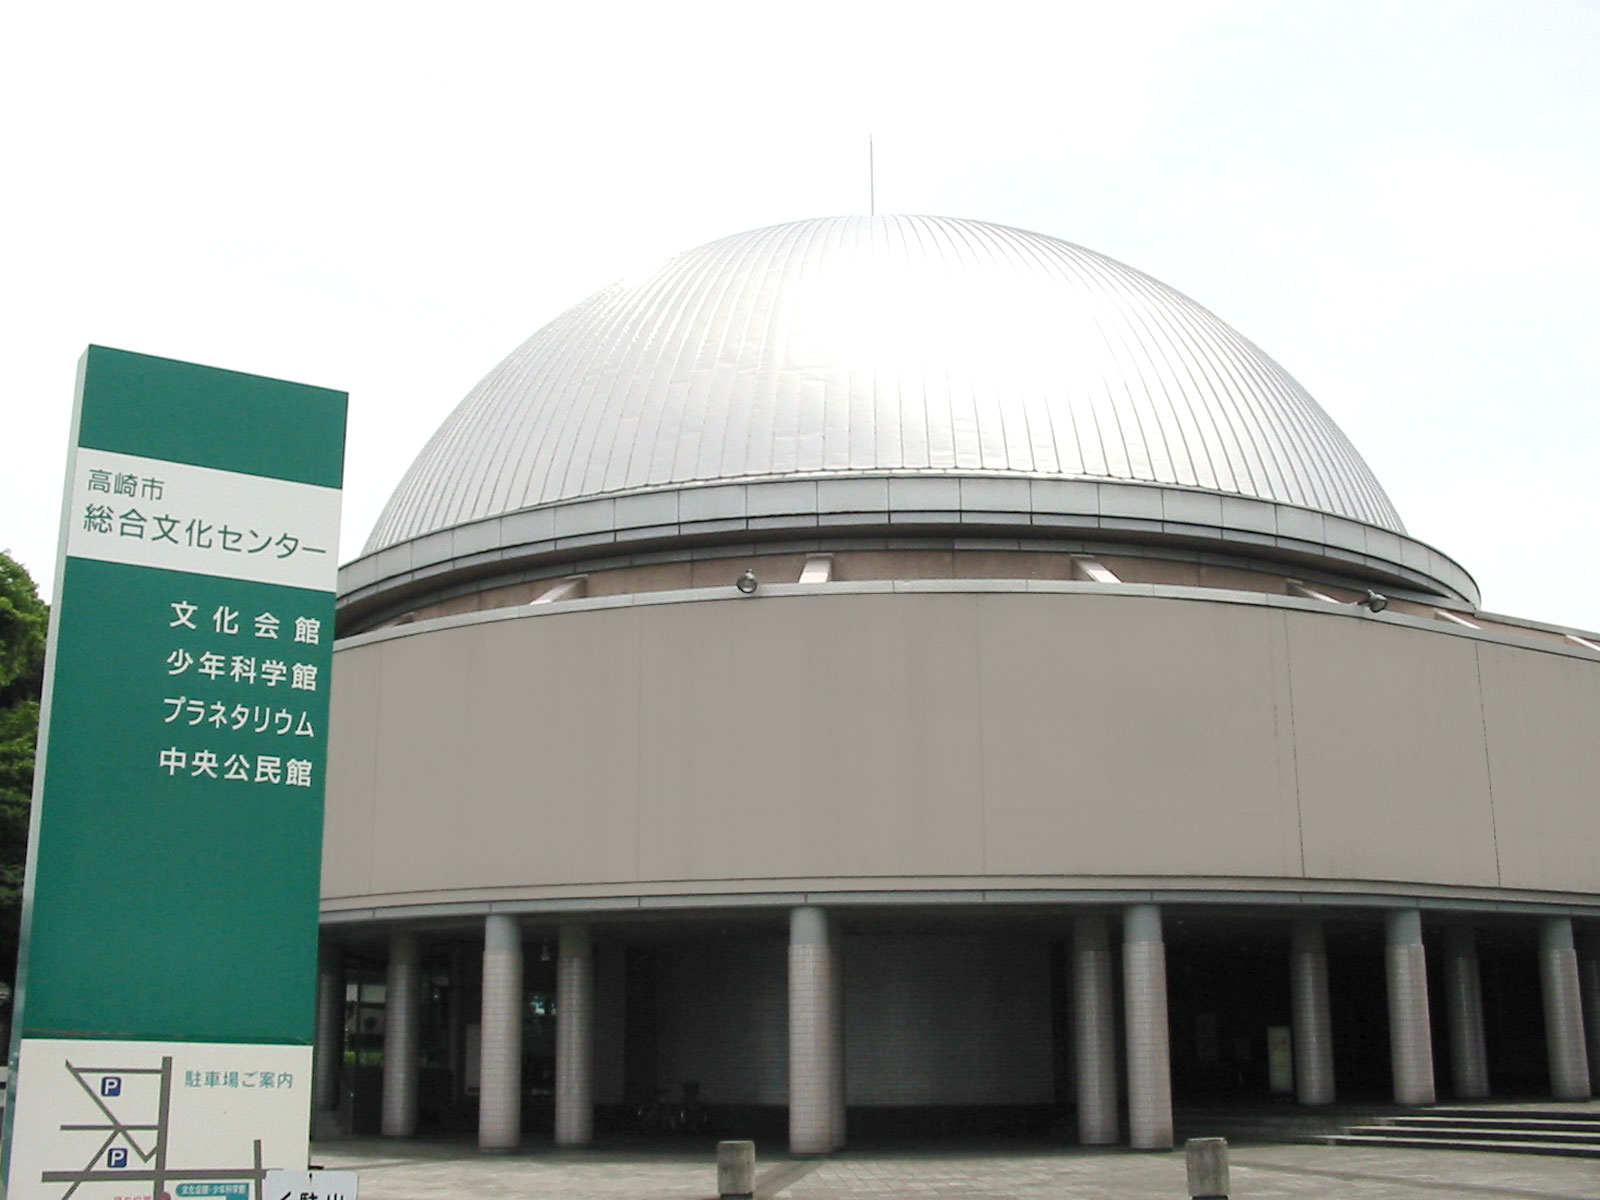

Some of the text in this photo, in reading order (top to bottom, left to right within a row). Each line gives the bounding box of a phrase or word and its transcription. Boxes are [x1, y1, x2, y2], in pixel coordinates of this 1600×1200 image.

[88, 469, 165, 500] 高崎市
[83, 503, 327, 559] 総合文化センター
[166, 648, 317, 691] 少年科学館
[163, 695, 315, 737] プラネタリウム
[159, 747, 313, 787] 中央公民館
[184, 1070, 293, 1088] 駐車場ご案内
